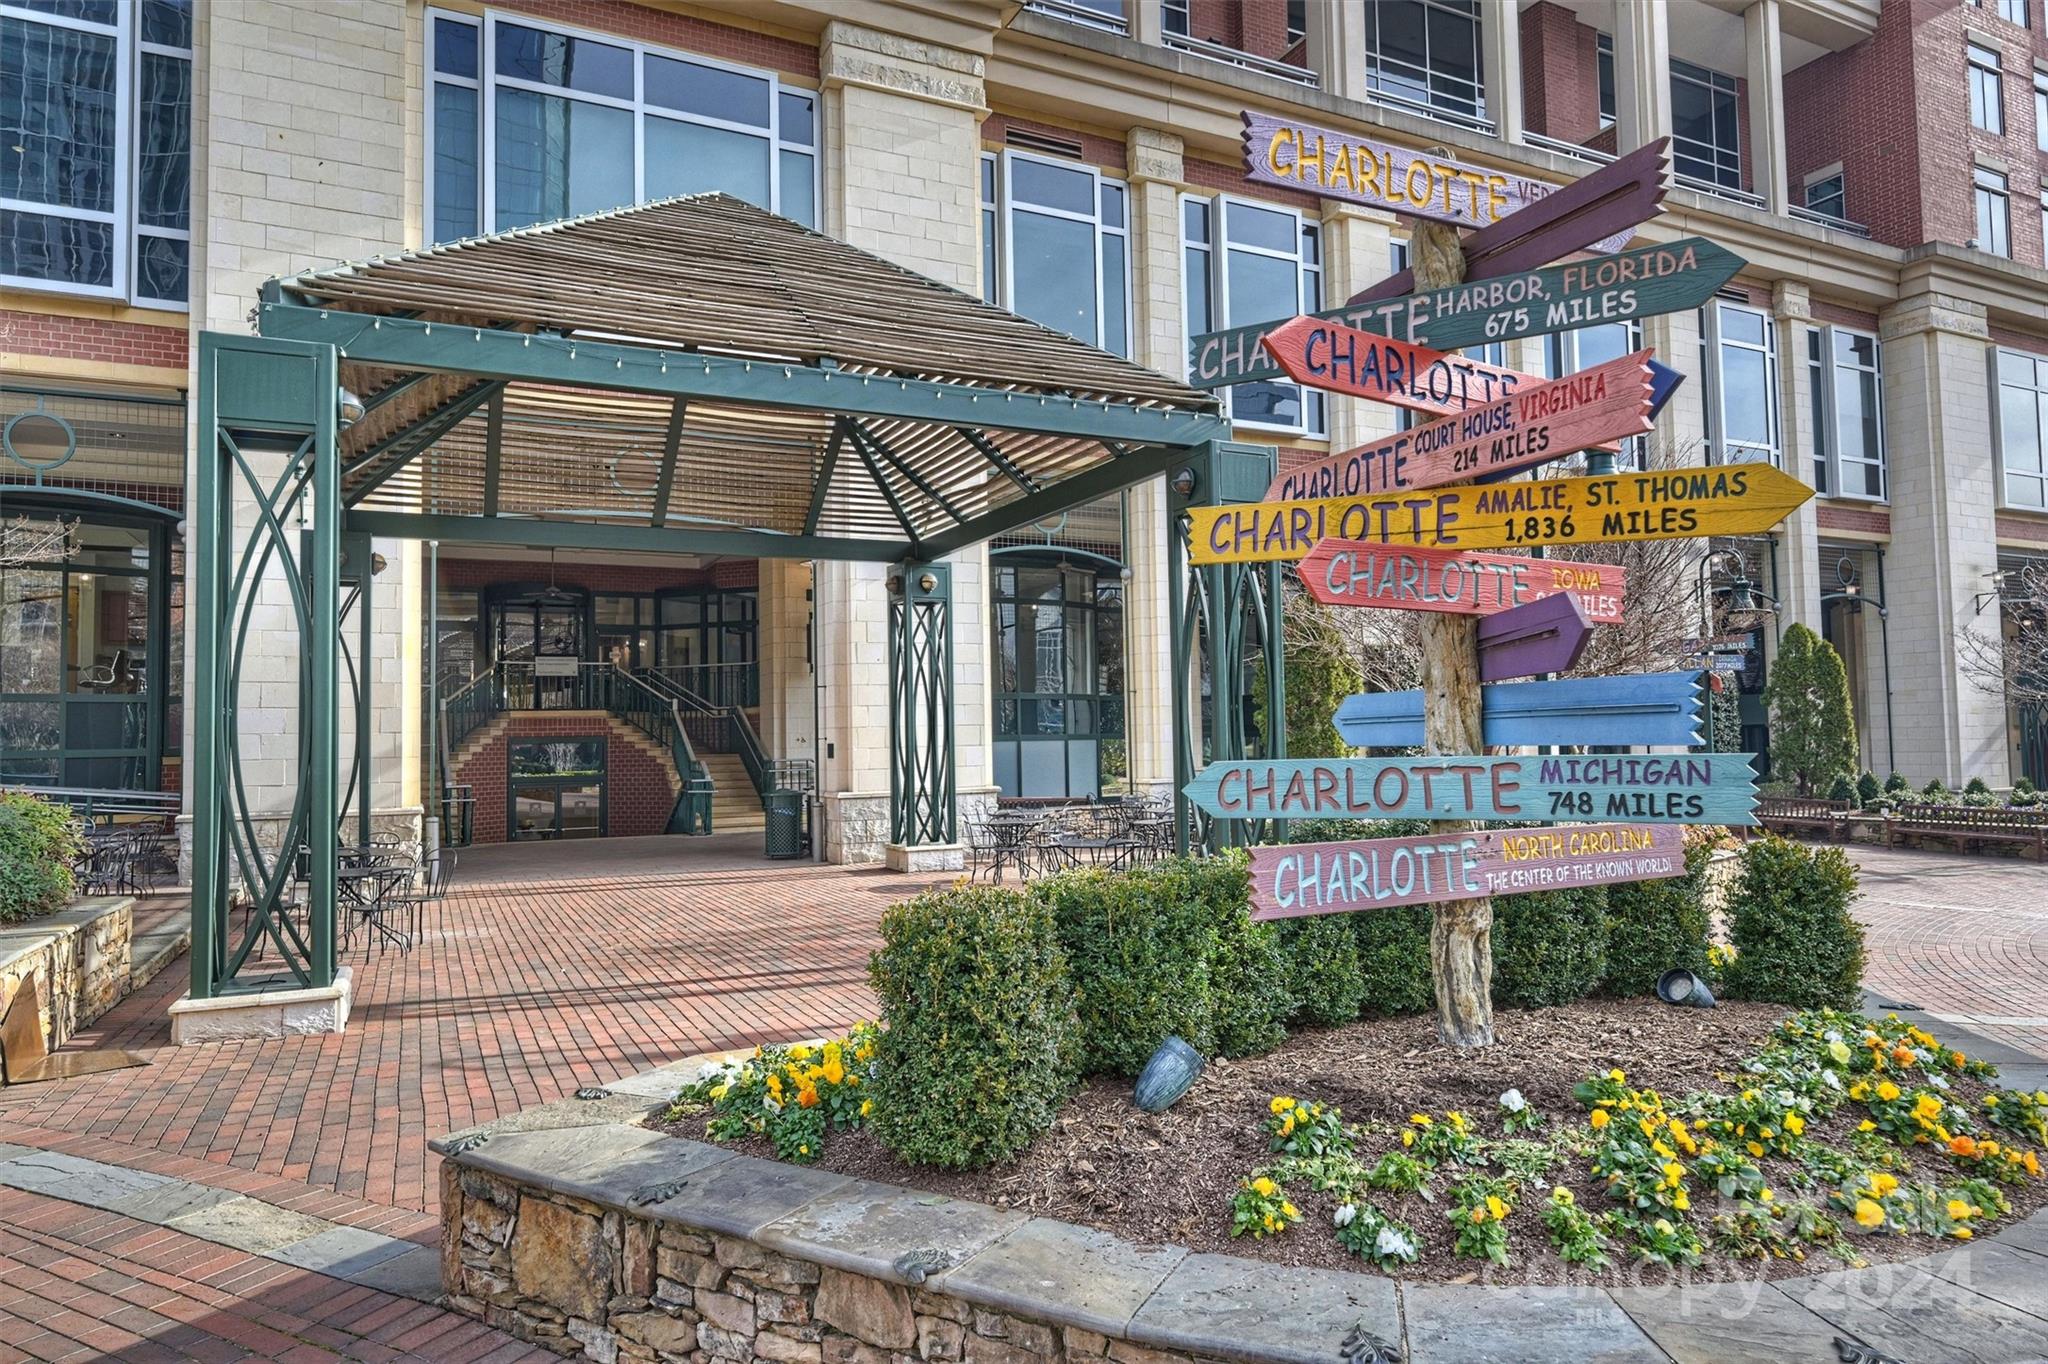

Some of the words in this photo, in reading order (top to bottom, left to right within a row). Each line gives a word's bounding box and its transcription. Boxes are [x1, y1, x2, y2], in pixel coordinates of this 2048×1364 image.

[1269, 127, 1507, 223] CHARLOTTE
[1200, 295, 1431, 380] CHATTE
[1436, 275, 1550, 318] HARBOR,
[1563, 246, 1697, 295] FLORIDA
[1484, 308, 1530, 338] 675
[1546, 290, 1638, 327] MILES
[1282, 439, 1409, 501] CHARLOTTE
[1414, 421, 1457, 456] COURT
[1462, 401, 1516, 442] HOUSE,
[1519, 372, 1606, 423] VIRGINIA
[1453, 450, 1479, 472] 214
[1490, 426, 1549, 464] MILES
[1209, 494, 1461, 554] CHARLOTTE
[1475, 484, 1573, 514] AMALIE,
[1586, 480, 1621, 507] ST.
[1634, 471, 1748, 503] THOMAS
[1504, 515, 1575, 544] 1,836
[1602, 507, 1698, 537] MILES
[1326, 550, 1529, 608] CHARLOTTE
[1551, 567, 1601, 591] IOWA
[1577, 594, 1618, 617] ILES
[1217, 762, 1522, 814] CHARLOTTE
[1539, 758, 1711, 786] MICHIGAN
[1548, 791, 1593, 816] 748
[1606, 792, 1704, 818] MILES
[1275, 838, 1481, 909] CHARLOTTE
[1502, 832, 1564, 863] NORTH
[1570, 827, 1655, 857] CAROLINA
[1485, 872, 1508, 891] THE
[1511, 866, 1553, 887] CENTER
[1556, 865, 1570, 884] OF
[1572, 863, 1594, 881] THE
[1594, 861, 1634, 879] KNOWN
[1636, 857, 1673, 876] WORLD!
